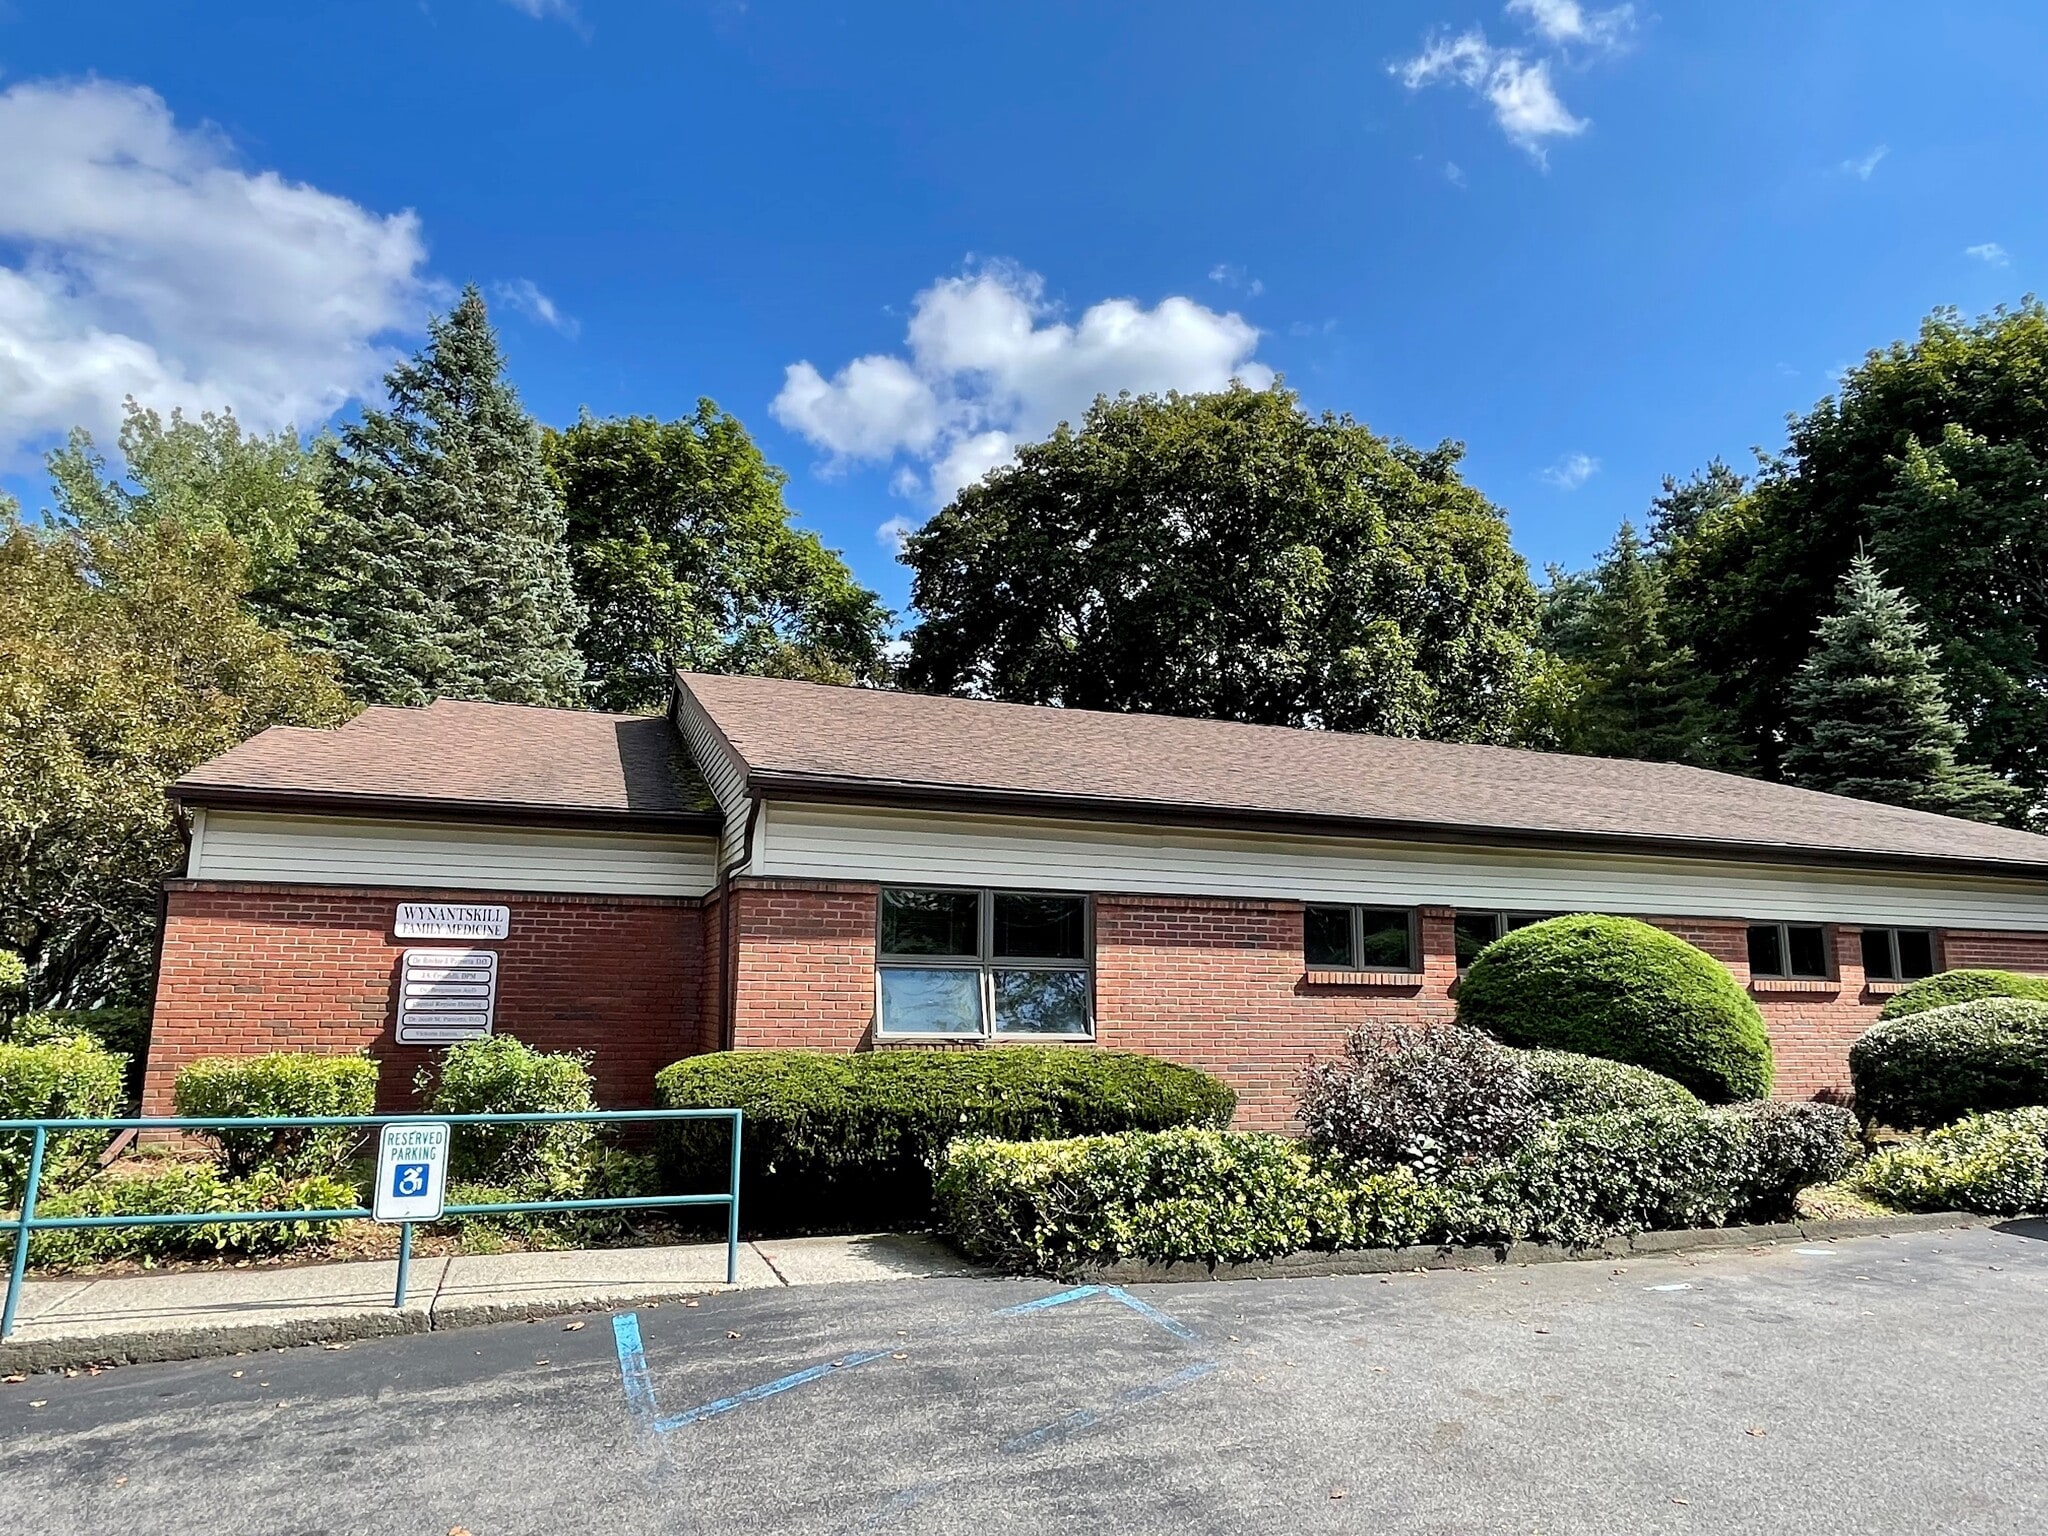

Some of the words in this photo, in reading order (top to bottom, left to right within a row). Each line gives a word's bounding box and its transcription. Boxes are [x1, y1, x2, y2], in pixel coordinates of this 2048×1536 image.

[403, 906, 503, 922] WYNANTSKILL
[402, 922, 444, 935] FAMILY
[446, 923, 502, 936] MEDICINE
[387, 1131, 443, 1145] RESERVED
[390, 1147, 437, 1161] PARKING
